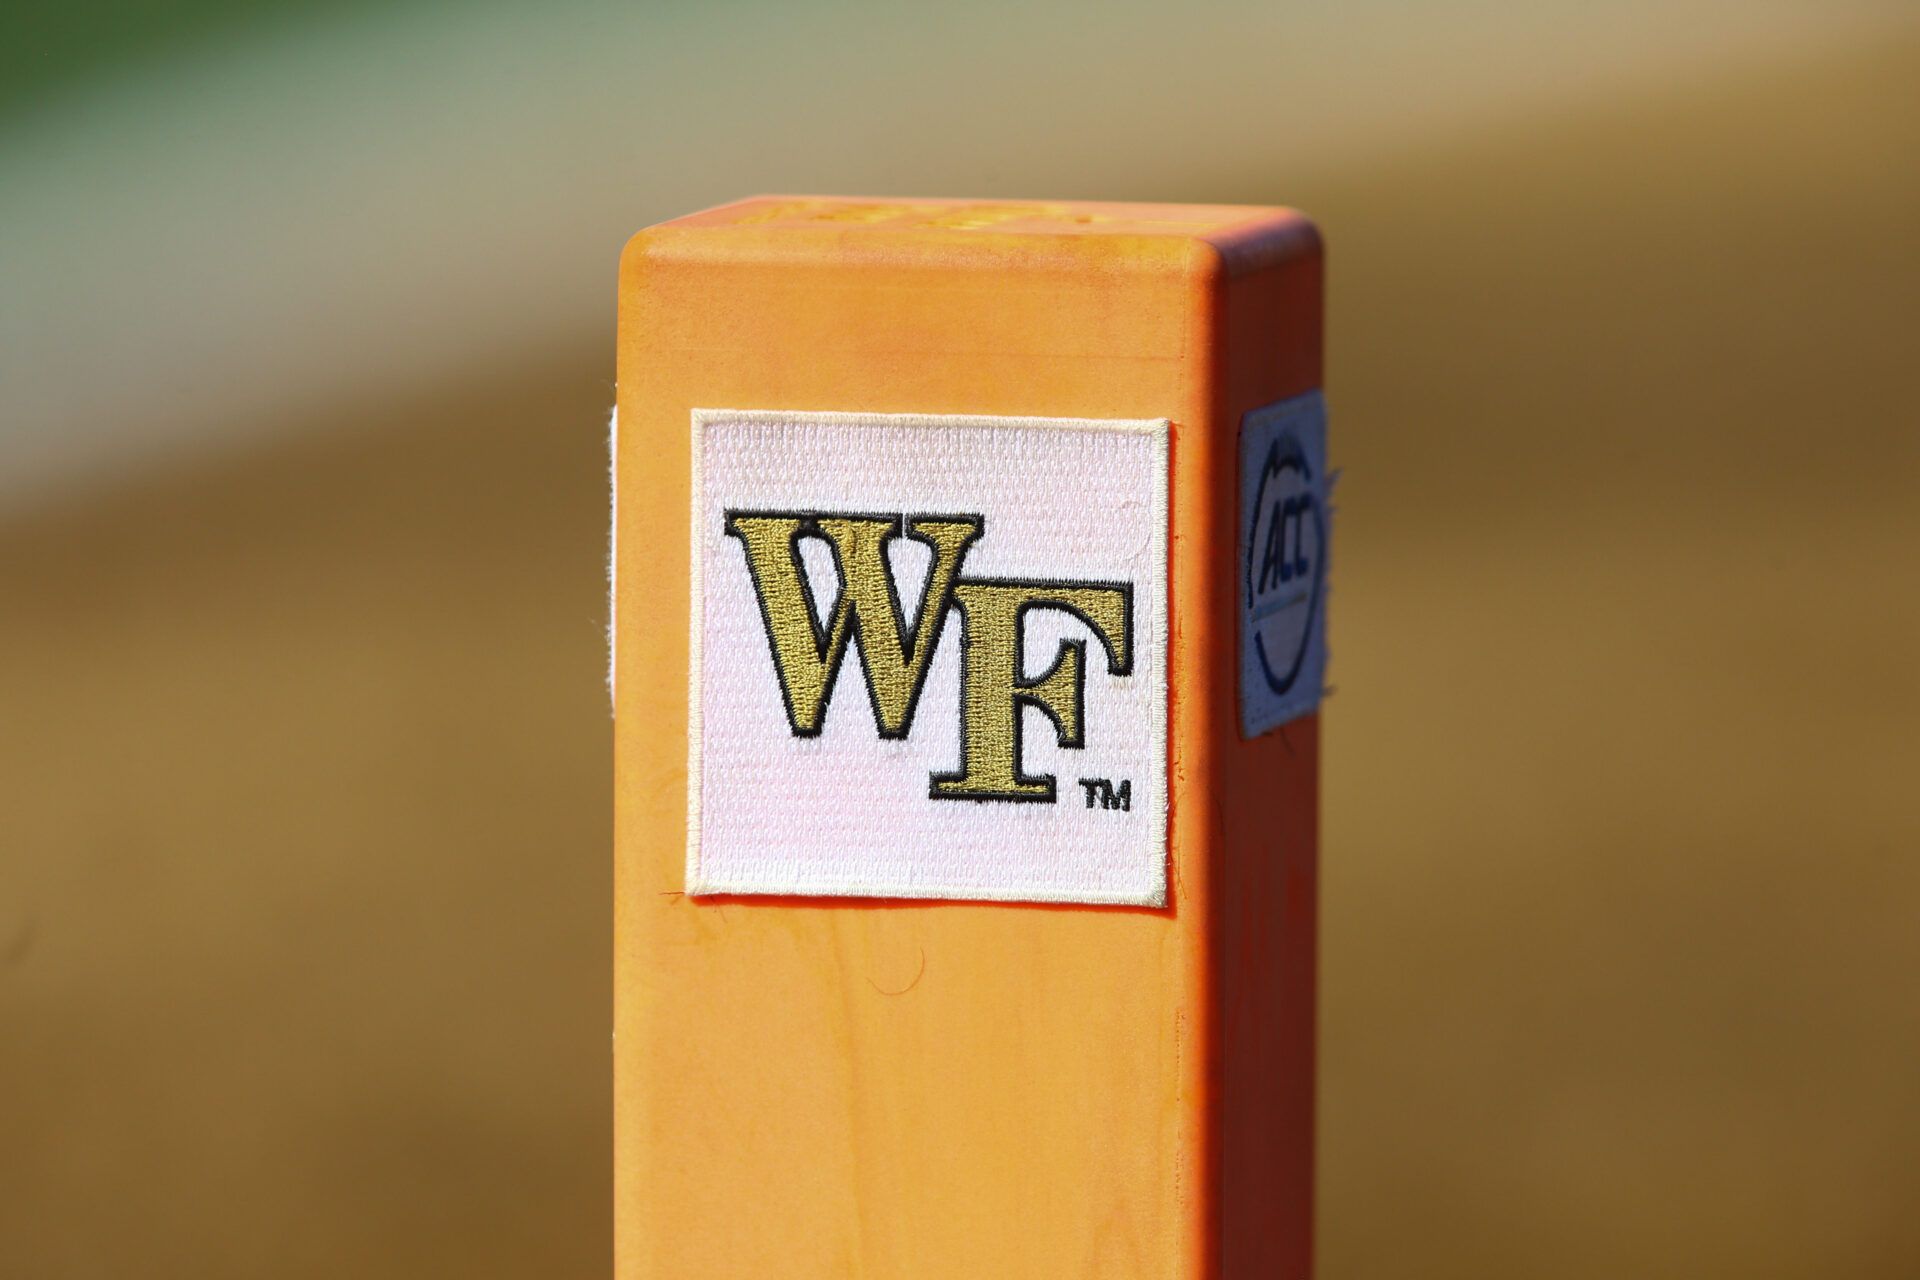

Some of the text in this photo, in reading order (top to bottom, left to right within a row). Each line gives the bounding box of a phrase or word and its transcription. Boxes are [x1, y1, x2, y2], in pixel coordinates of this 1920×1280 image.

[1258, 493, 1313, 594] ACC
[724, 509, 1134, 804] WF
[1078, 778, 1131, 812] TM
